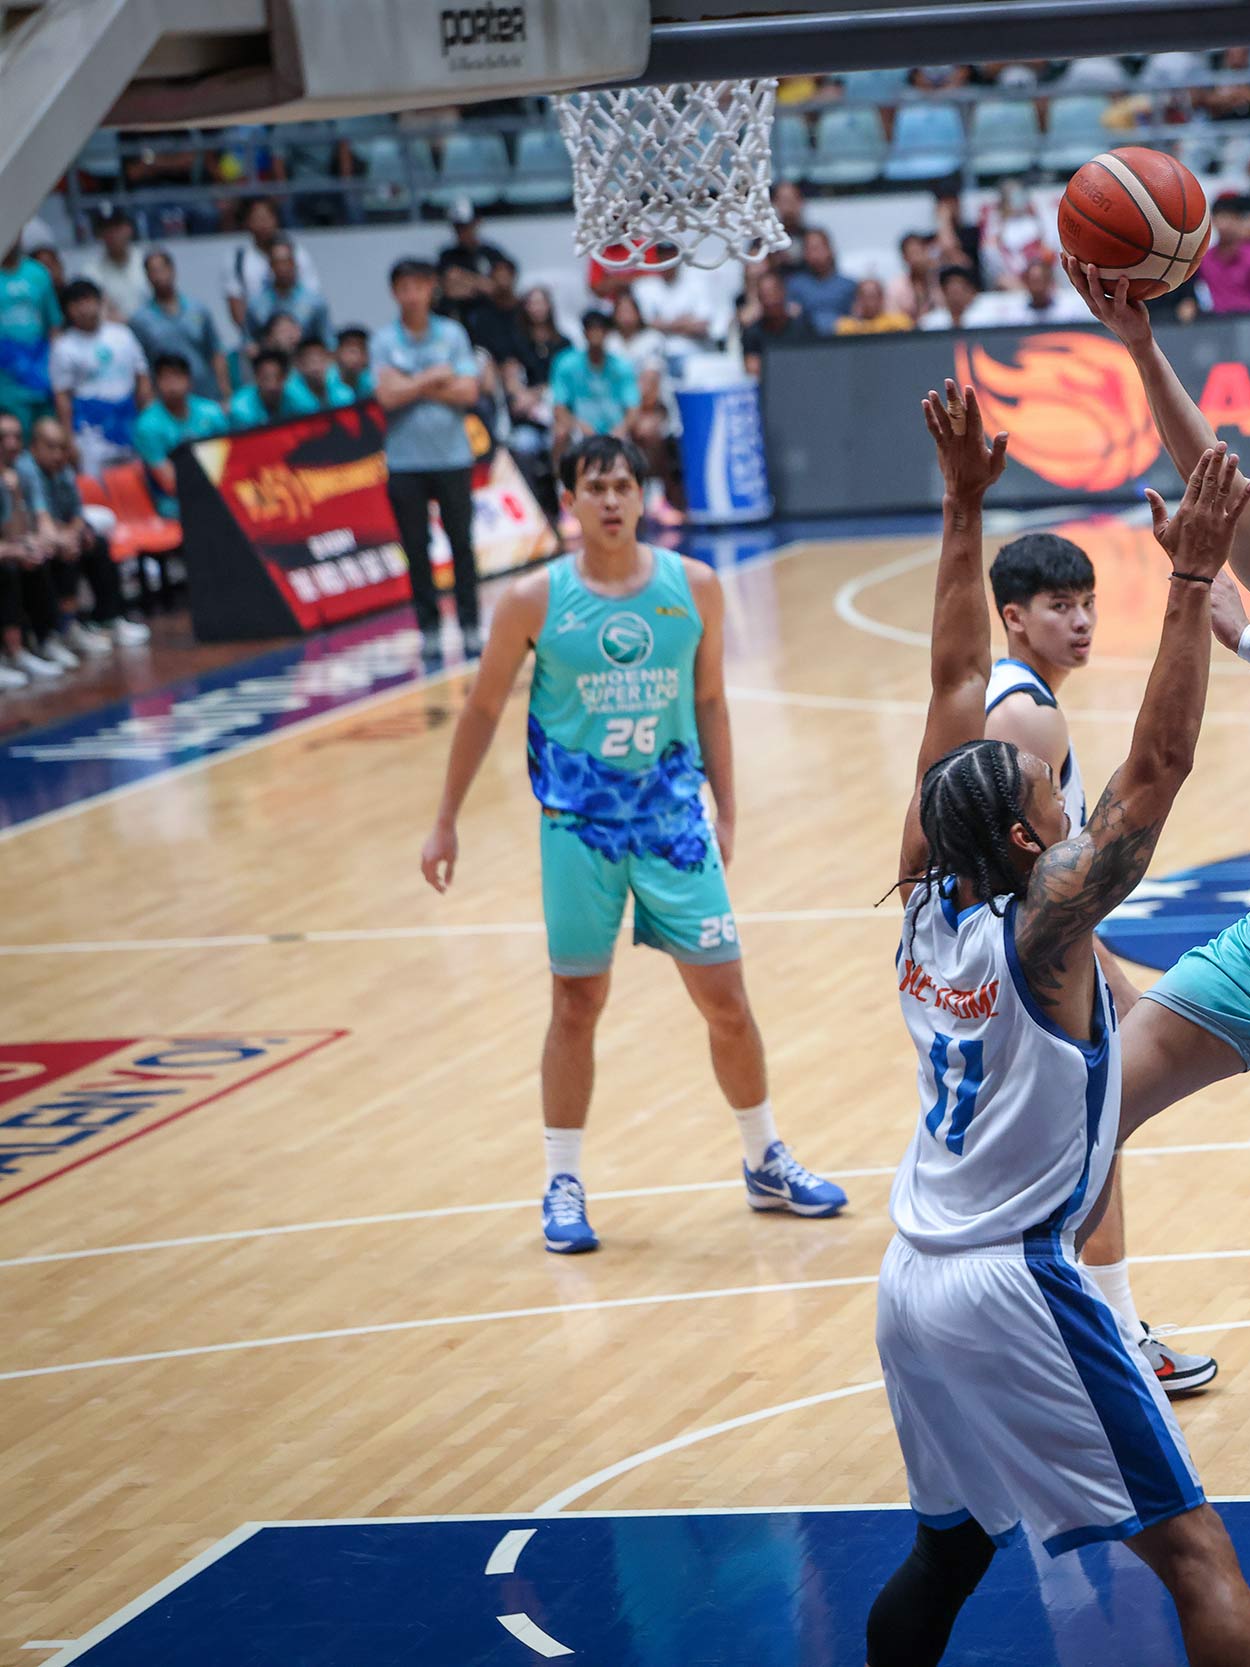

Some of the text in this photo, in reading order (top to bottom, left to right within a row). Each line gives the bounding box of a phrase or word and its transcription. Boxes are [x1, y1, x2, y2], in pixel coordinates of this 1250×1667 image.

[1073, 174, 1113, 213] molten
[601, 715, 660, 757] 26
[699, 912, 736, 949] 26
[925, 1031, 984, 1157] 11
